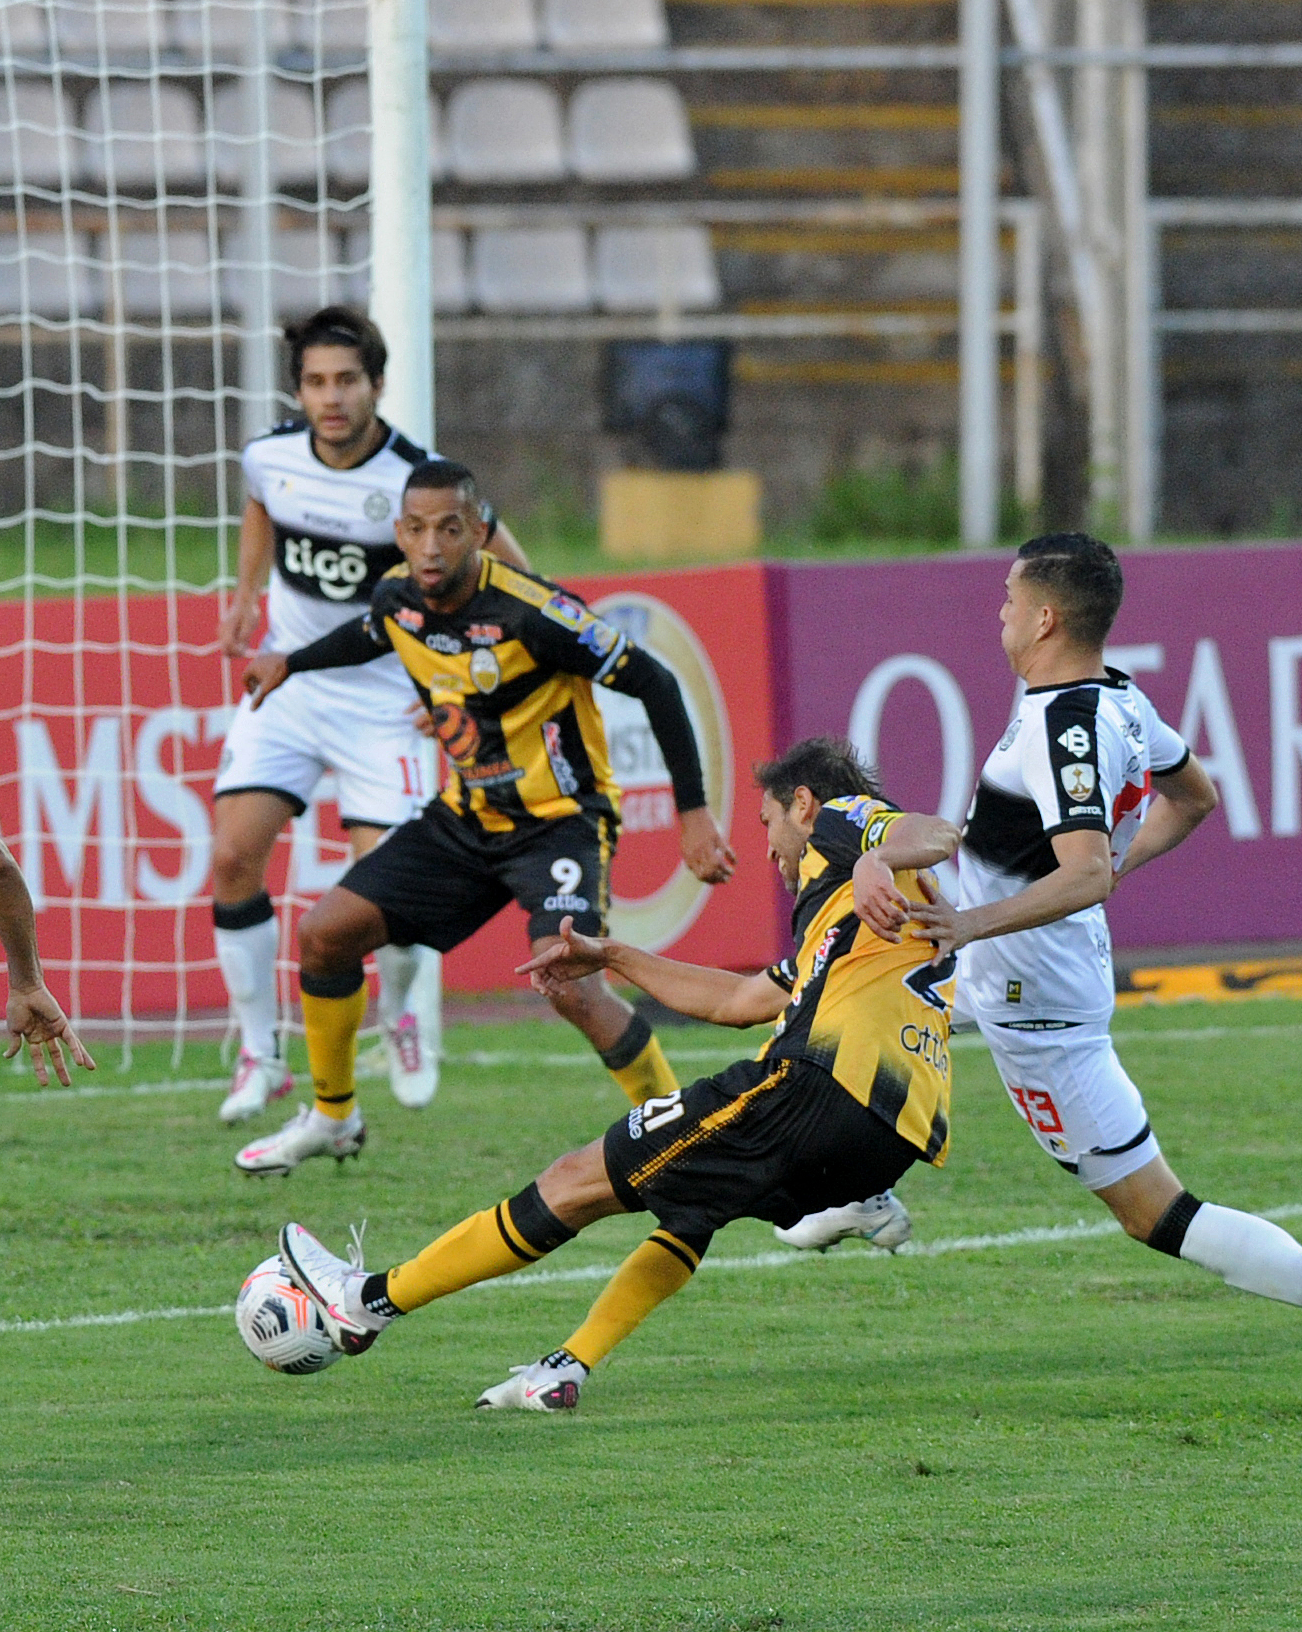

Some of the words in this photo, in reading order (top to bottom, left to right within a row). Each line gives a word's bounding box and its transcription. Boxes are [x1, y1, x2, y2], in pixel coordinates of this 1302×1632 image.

[285, 538, 367, 600] tigo
[398, 756, 424, 797] 11
[550, 857, 583, 894] 9
[643, 1089, 685, 1133] 21
